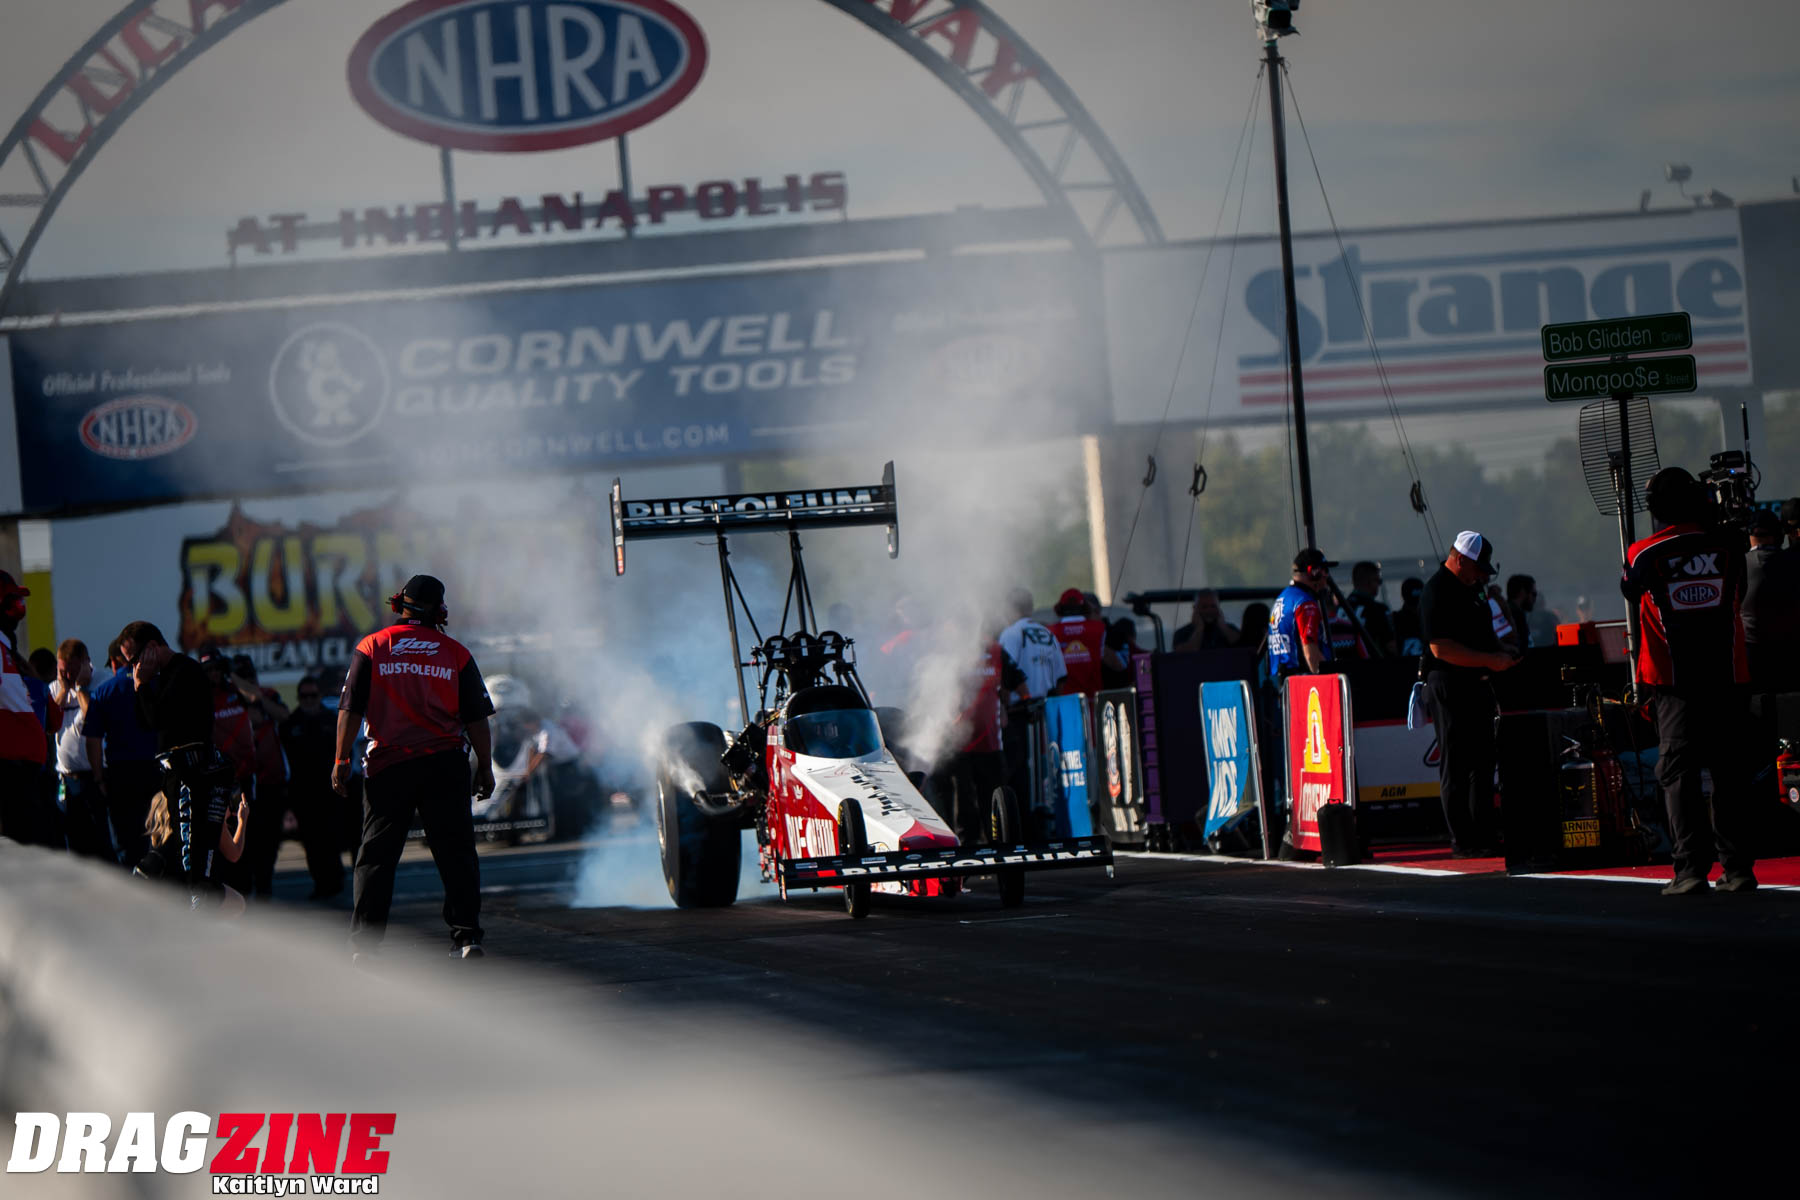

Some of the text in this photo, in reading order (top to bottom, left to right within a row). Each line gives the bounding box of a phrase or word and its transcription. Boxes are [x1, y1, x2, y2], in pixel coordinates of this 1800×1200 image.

[403, 4, 662, 121] NHRA
[232, 171, 847, 255] AT INDIANAPOLIS
[1238, 243, 1745, 368] Strange
[399, 308, 852, 380] CORNWELL
[1550, 331, 1583, 354] Bob
[1587, 326, 1652, 350] Glidden
[394, 354, 858, 416] QUALITY TOOLS
[1552, 365, 1660, 395] Mongoo$e
[100, 405, 186, 446] NHRA
[1668, 552, 1721, 578] FOX
[1680, 586, 1716, 602] NHRA
[378, 662, 452, 680] RUST-OLEUM
[1381, 785, 1407, 798] AGM
[1561, 820, 1599, 832] ARNING
